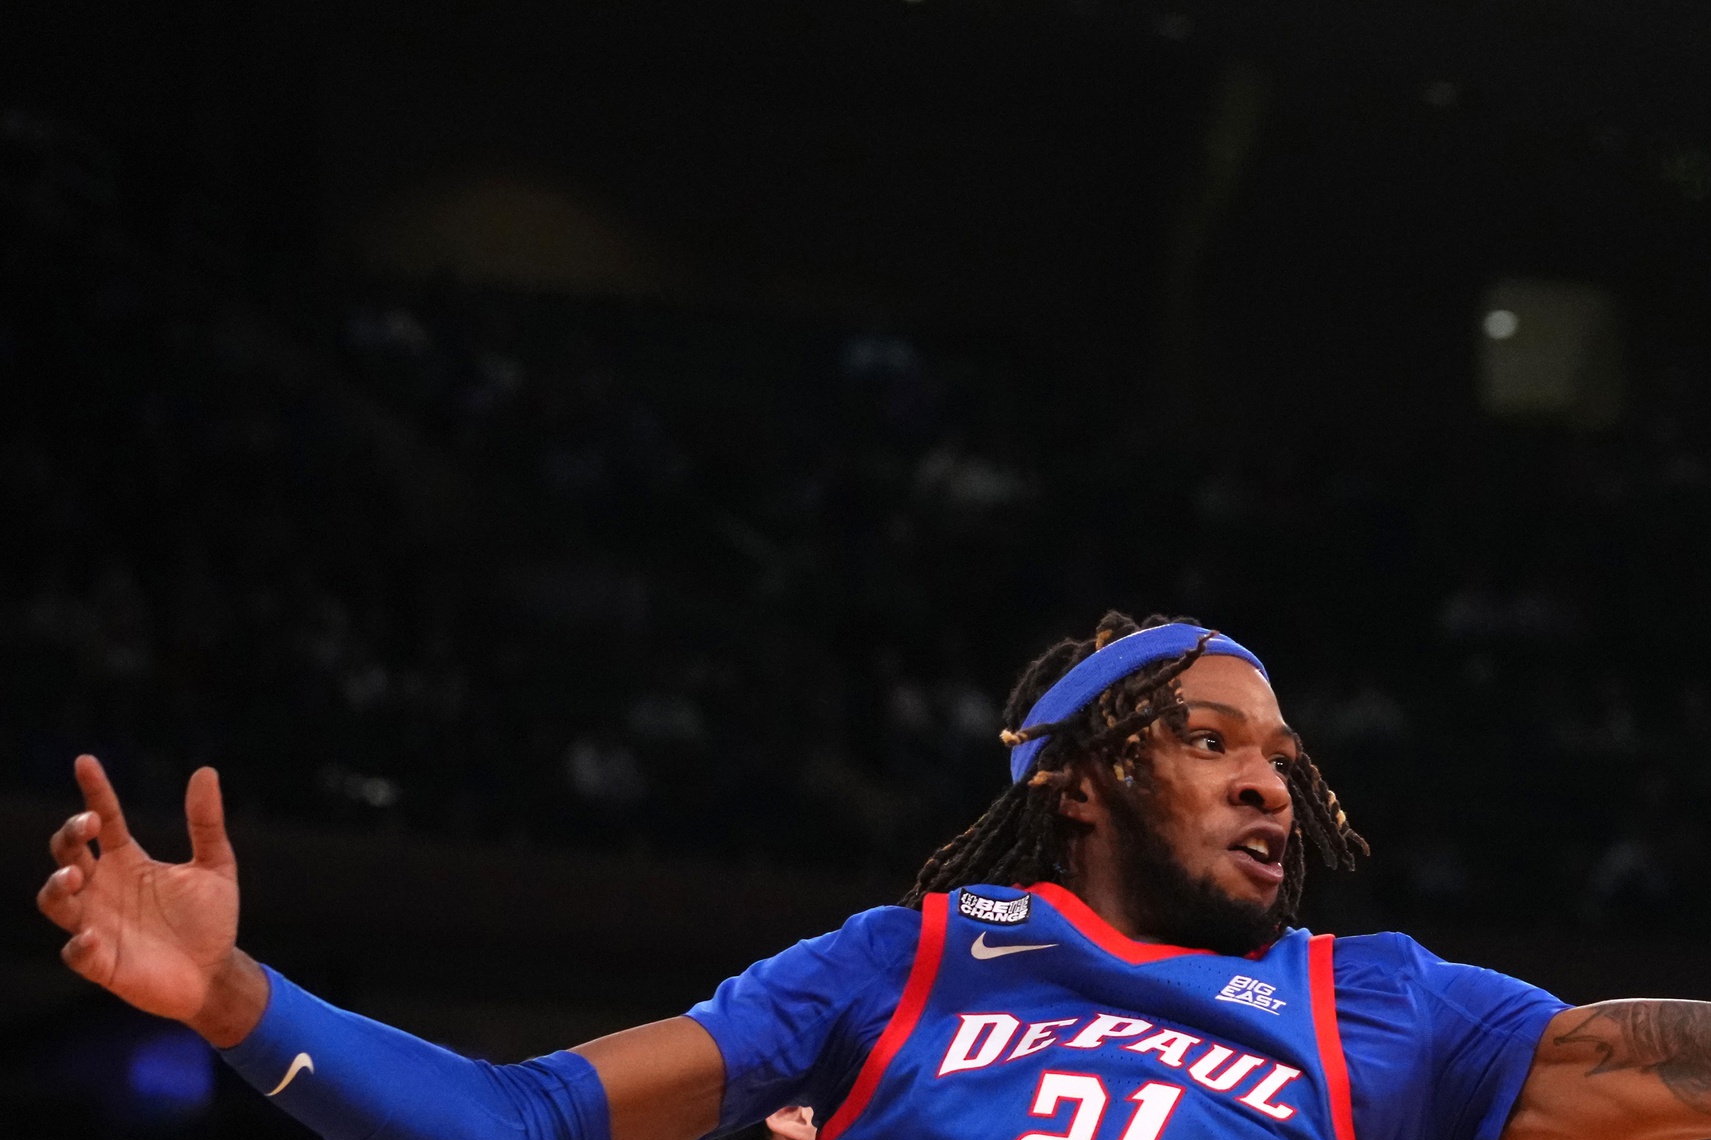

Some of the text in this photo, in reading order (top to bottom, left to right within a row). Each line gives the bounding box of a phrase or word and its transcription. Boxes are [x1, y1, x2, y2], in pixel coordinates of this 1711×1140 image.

[960, 904, 1029, 922] CHANGE
[975, 898, 1010, 914] BE
[1229, 975, 1276, 996] BIG
[1220, 985, 1287, 1010] EAST
